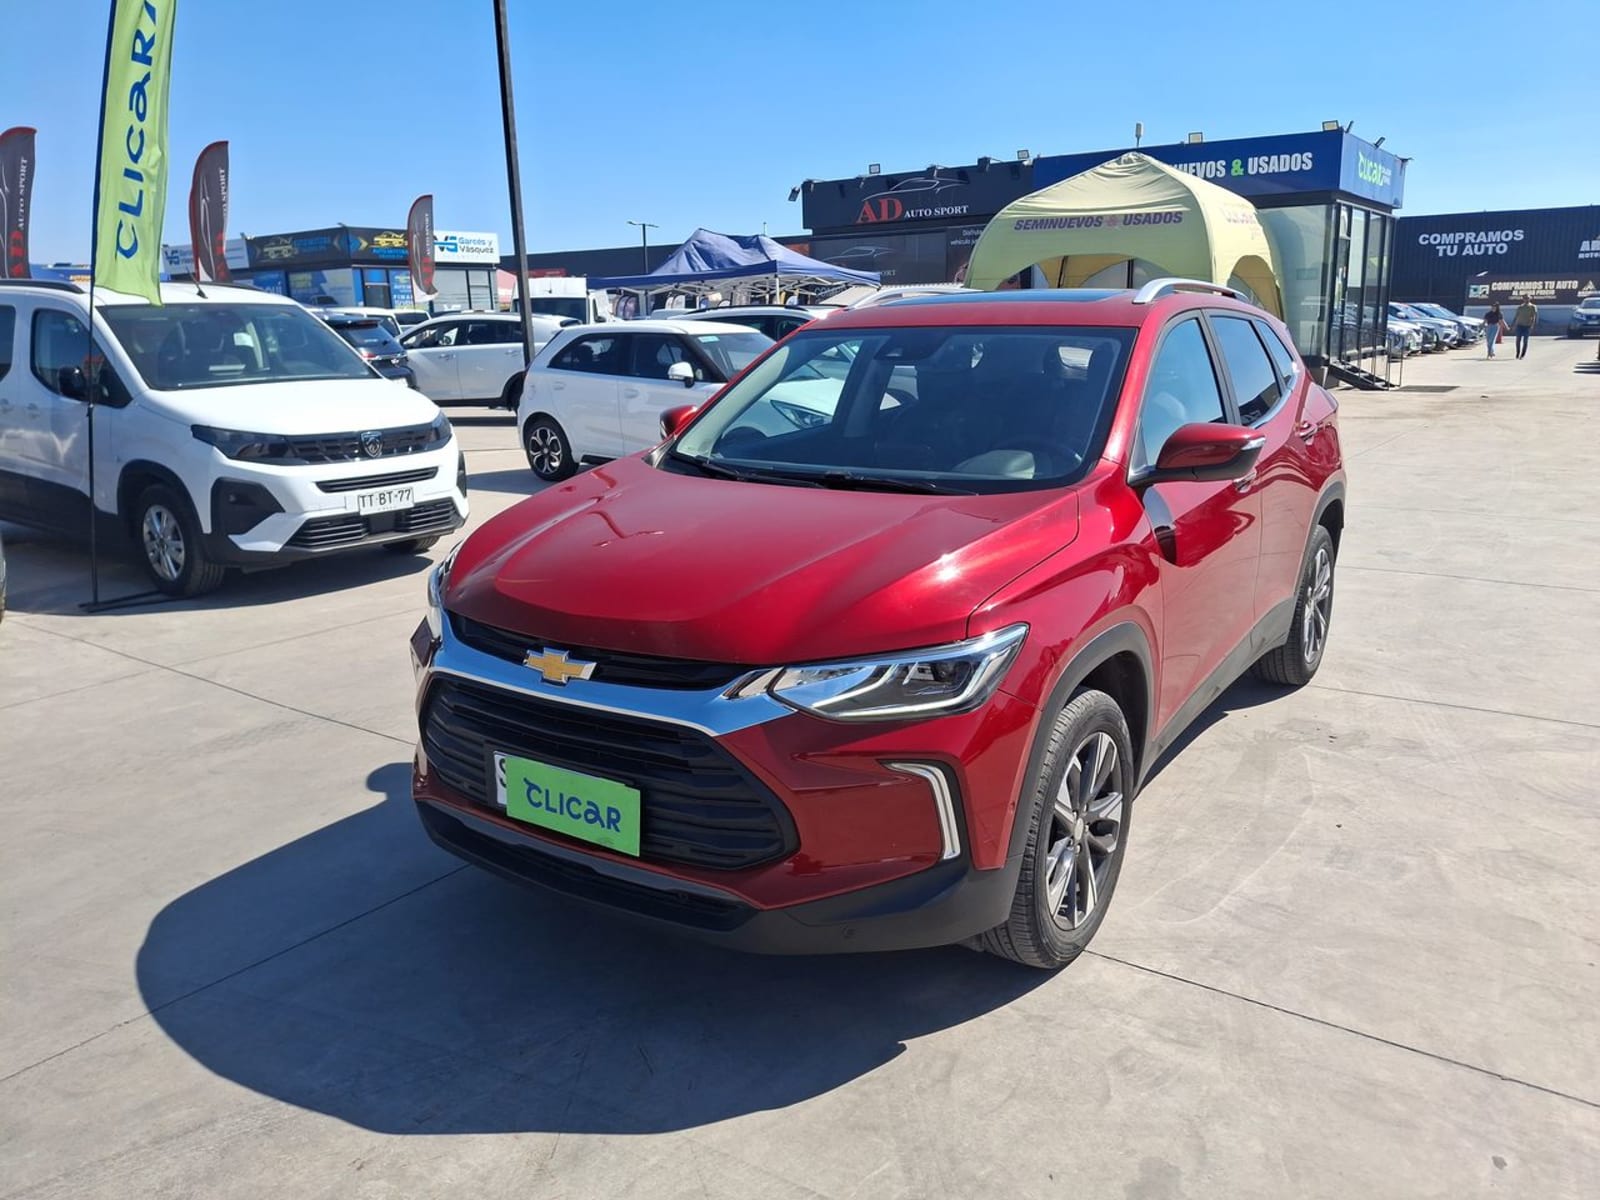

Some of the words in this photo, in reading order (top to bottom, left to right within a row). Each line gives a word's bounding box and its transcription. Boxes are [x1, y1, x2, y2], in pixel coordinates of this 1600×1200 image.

[18, 155, 28, 194] SPORT
[1171, 159, 1227, 179] UEVOS
[1230, 158, 1244, 177] &
[1247, 151, 1313, 175] USADOS
[855, 197, 903, 223] AD
[903, 207, 932, 219] AUTO
[933, 204, 969, 217] SPORT
[1014, 215, 1104, 231] SEMINUEVOS
[1122, 210, 1184, 226] USADOS
[1418, 229, 1525, 245] COMPRAMOS
[1435, 245, 1458, 257] TU
[1462, 242, 1509, 256] AUTO
[1491, 281, 1543, 291] COMPRAMOS
[1556, 280, 1579, 289] AUTO
